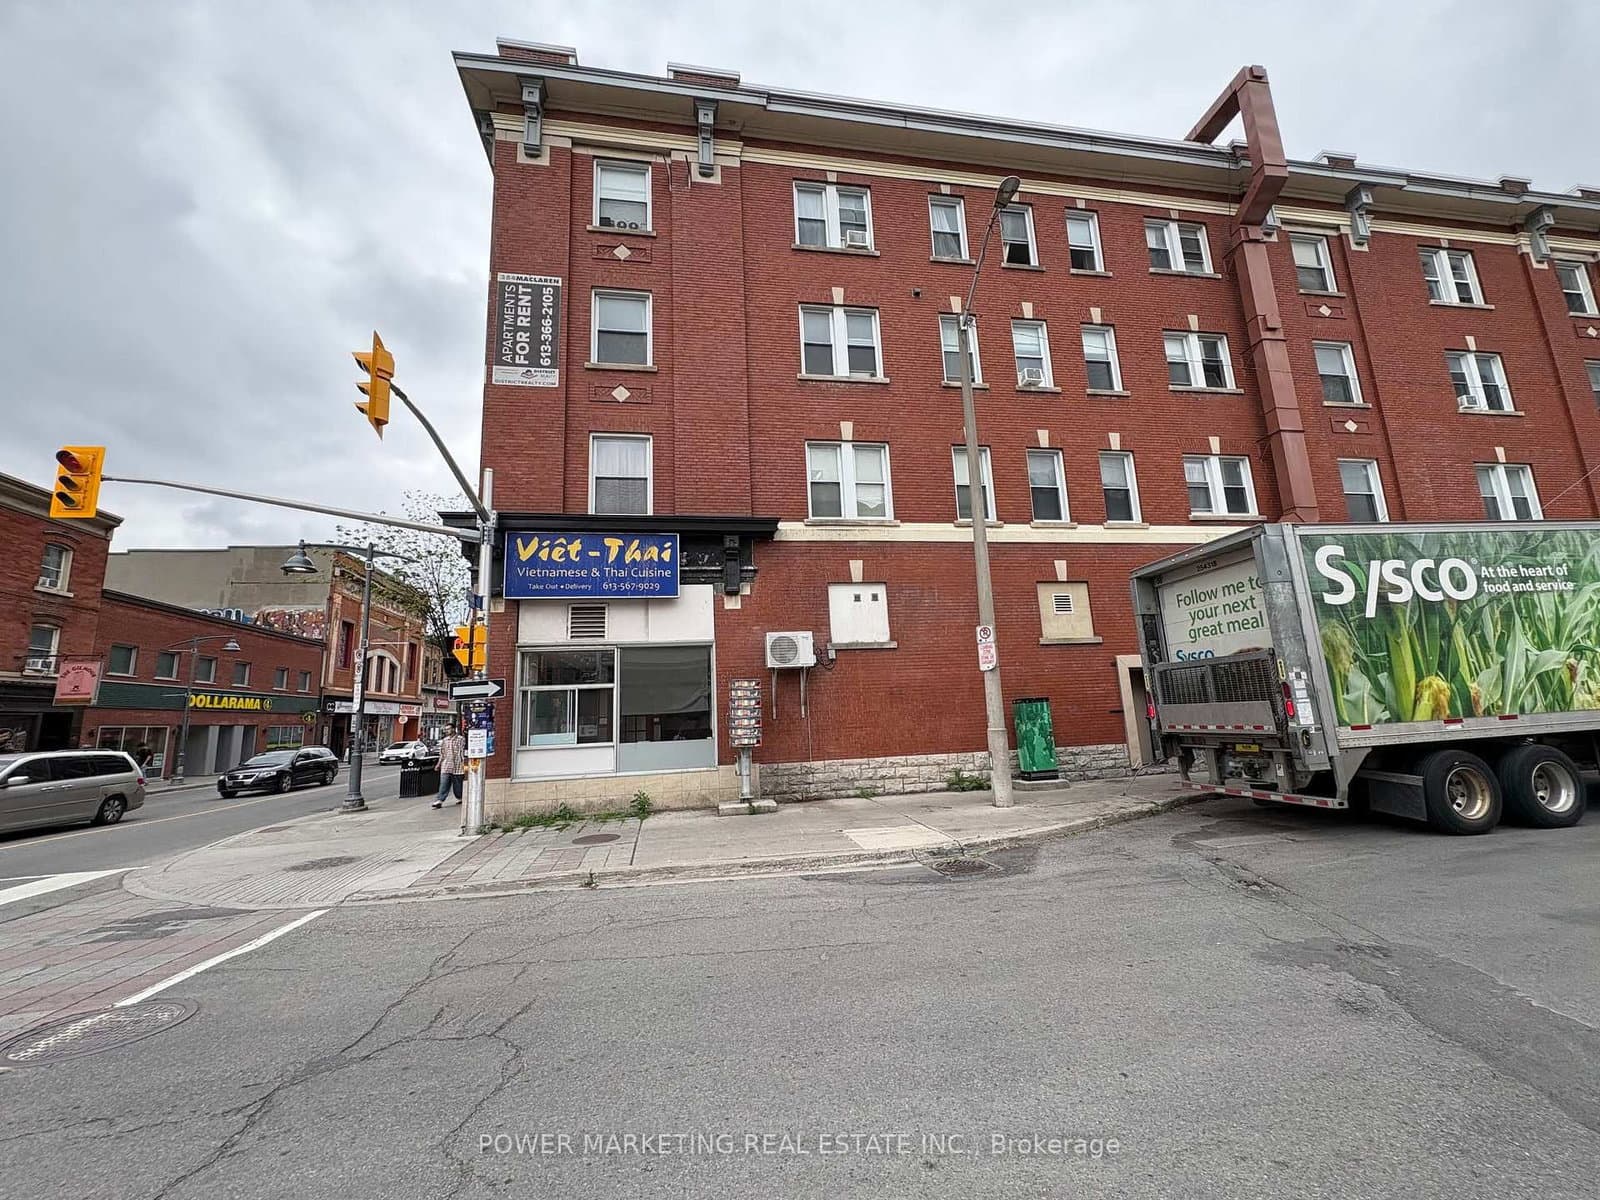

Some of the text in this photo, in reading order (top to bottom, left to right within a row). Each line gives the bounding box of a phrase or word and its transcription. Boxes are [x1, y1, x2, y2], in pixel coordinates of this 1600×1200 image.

[502, 284, 516, 363] APARTMENTS
[515, 284, 532, 364] FOR RENT
[540, 287, 554, 366] 613-366-2105
[603, 537, 673, 564] Thai
[517, 567, 672, 577] Vietnamese & Thai Cuisine
[1481, 563, 1568, 578] At the heart of
[565, 583, 592, 591] Delivery
[602, 582, 660, 591] 613-567-9029
[1176, 587, 1218, 608] Follow
[1222, 580, 1245, 597] me
[1483, 579, 1574, 593] food and service
[1189, 595, 1256, 626] your next
[1188, 610, 1264, 643] great meal
[189, 694, 260, 710] DOLLARAMA
